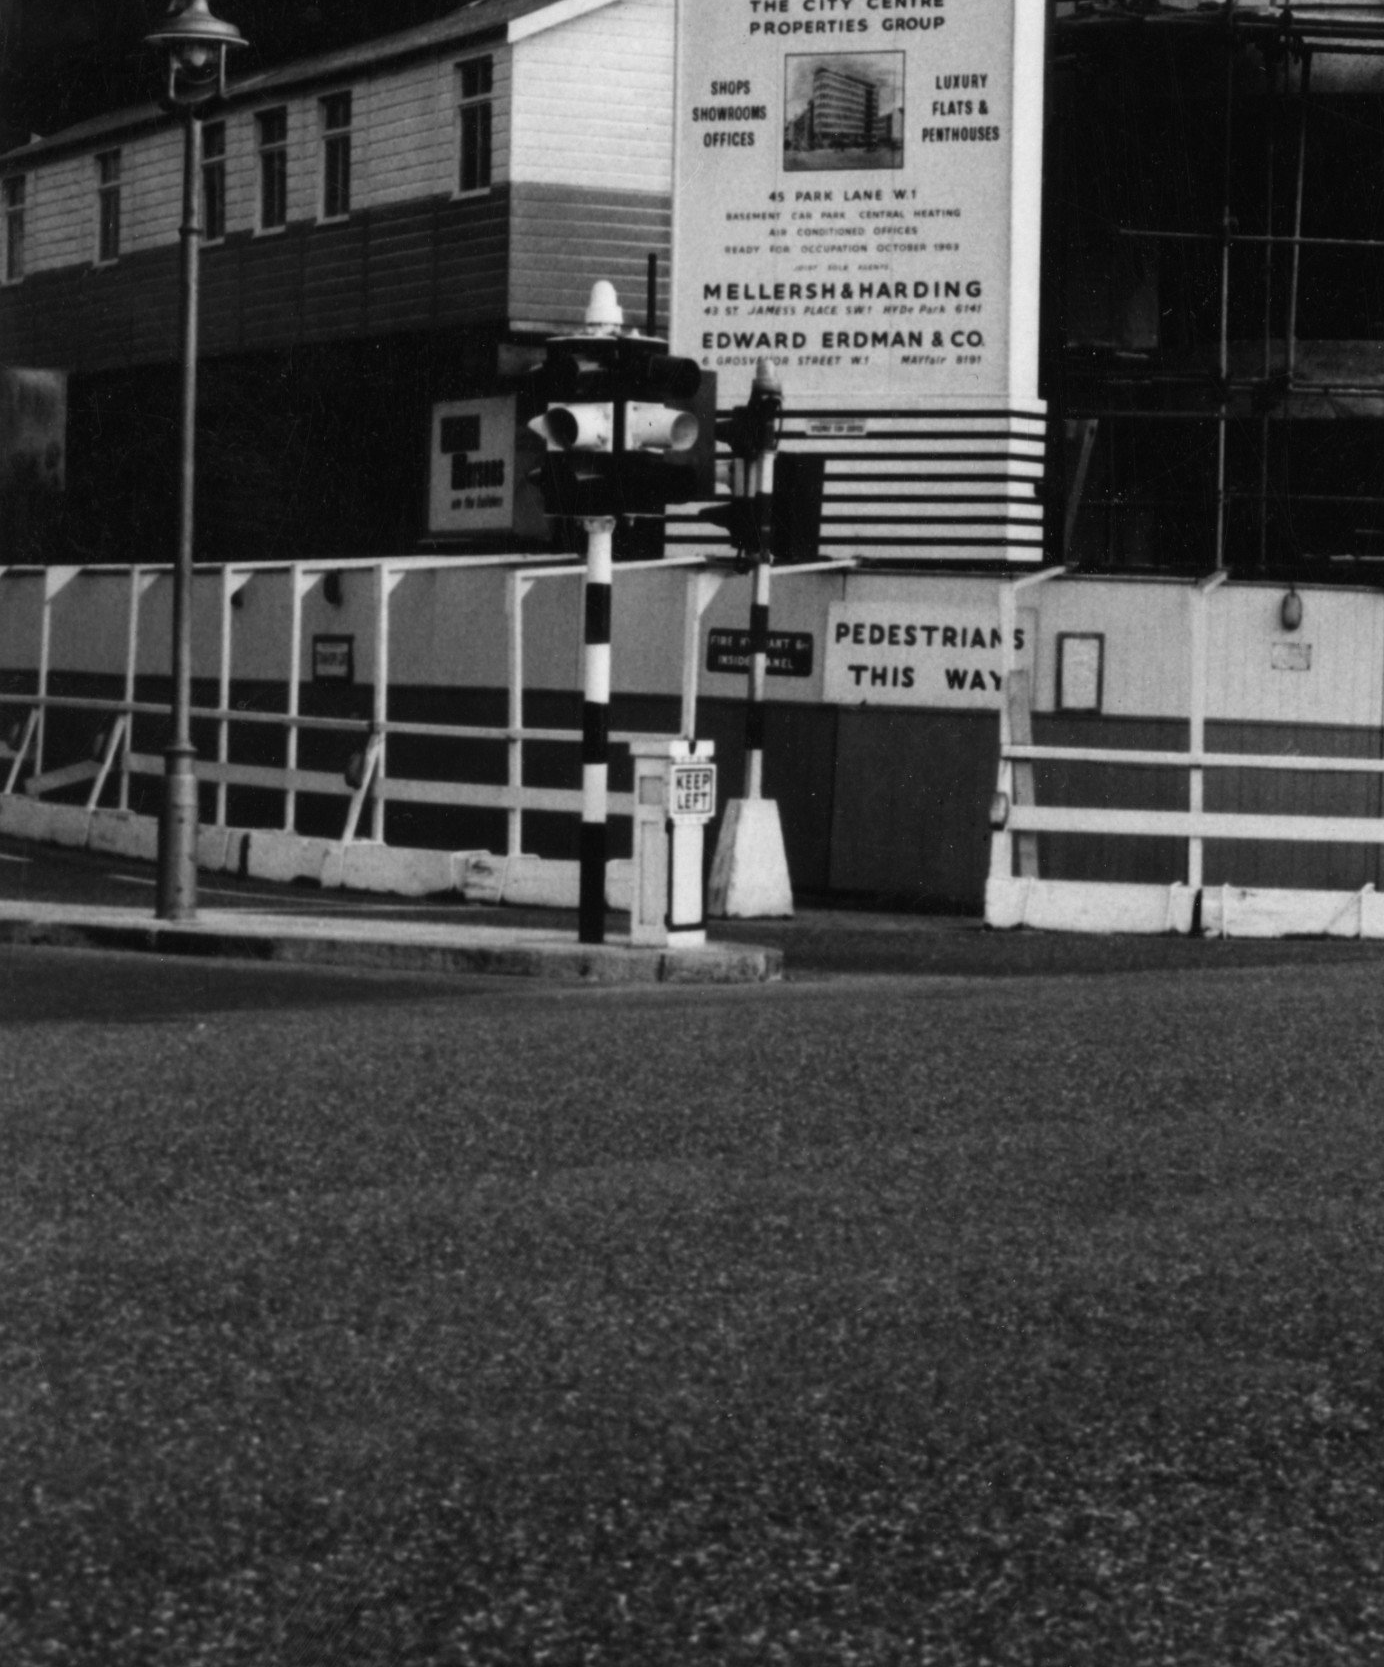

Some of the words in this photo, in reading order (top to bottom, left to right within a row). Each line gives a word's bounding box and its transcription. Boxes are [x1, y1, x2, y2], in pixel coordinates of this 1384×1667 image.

[750, 19, 869, 35] PROPERTIES
[882, 16, 945, 32] GROUP
[711, 80, 751, 96] SHOPS
[935, 73, 988, 90] LUXURY
[692, 105, 767, 122] SHOWROOMS
[932, 101, 973, 116] FLATS
[978, 99, 989, 115] &
[703, 131, 755, 148] OFFICES
[922, 126, 999, 143] PENTHOUSES
[769, 191, 785, 203] 45
[795, 191, 833, 202] PARK
[844, 189, 883, 201] LANE
[726, 212, 781, 221] BASEMENT
[791, 212, 812, 221] CAR
[821, 212, 845, 220] PARK
[859, 210, 905, 219] CENTRAL
[913, 208, 961, 218] HEATING
[769, 228, 787, 237] AIR
[797, 227, 865, 237] CONDITIONED
[873, 226, 918, 235] OFFICES
[725, 245, 760, 254] READY
[769, 245, 790, 254] FOR
[801, 244, 868, 253] OCCUPATION
[876, 242, 927, 252] OCTOBER
[803, 305, 838, 316] PLACE
[702, 331, 807, 349] EDWARD
[821, 330, 923, 349] ERDMAN
[931, 330, 944, 348] &
[797, 355, 841, 366] STREET
[764, 657, 793, 670] ANEL
[848, 665, 914, 688] THIS
[676, 773, 711, 790] KEEP
[677, 792, 708, 809] LEFT
